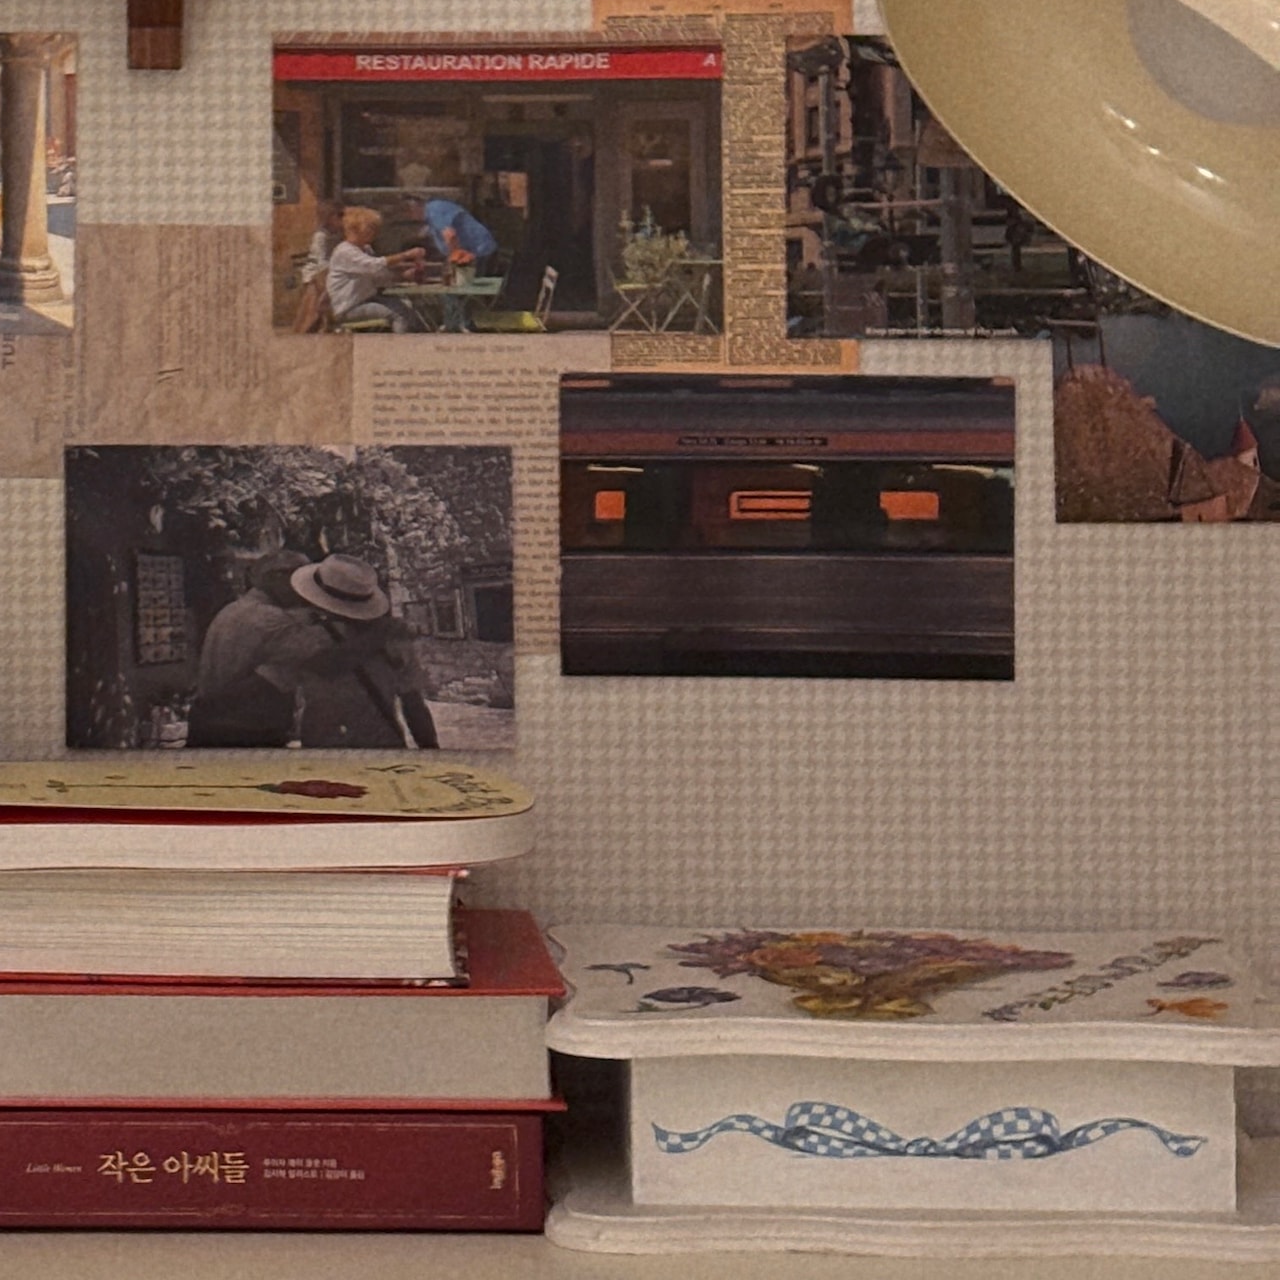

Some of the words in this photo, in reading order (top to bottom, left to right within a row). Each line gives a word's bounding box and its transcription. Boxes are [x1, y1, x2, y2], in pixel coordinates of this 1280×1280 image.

[355, 54, 523, 72] RESTAURATION
[528, 52, 611, 70] RAPIDE
[97, 1151, 157, 1184] 작은
[162, 1150, 250, 1184] 아씨들
